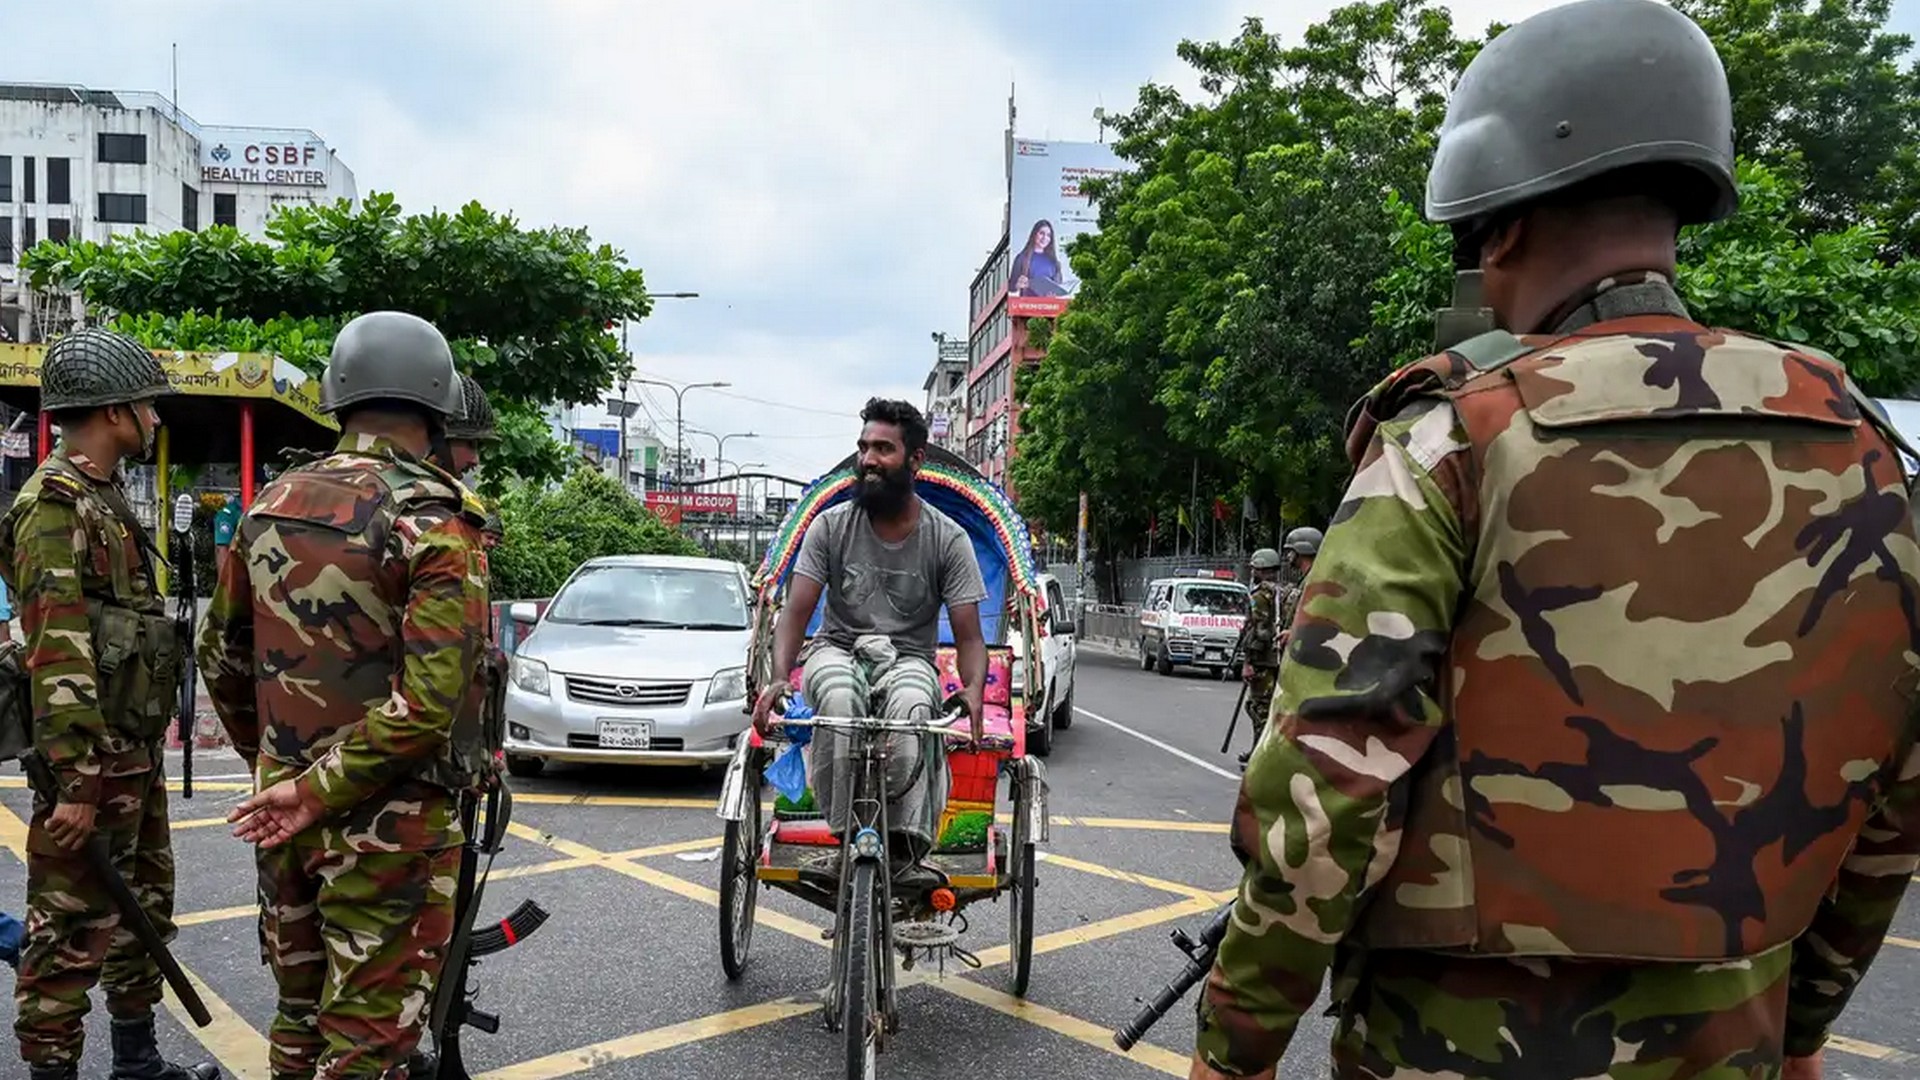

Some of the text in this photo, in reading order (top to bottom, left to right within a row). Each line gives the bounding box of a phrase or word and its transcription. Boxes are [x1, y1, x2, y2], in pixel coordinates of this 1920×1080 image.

[244, 145, 316, 165] CSBF
[201, 166, 324, 183] HEALTH CENTER
[657, 495, 733, 507] RAHM GROUP
[1182, 616, 1242, 629] AMBULANC
